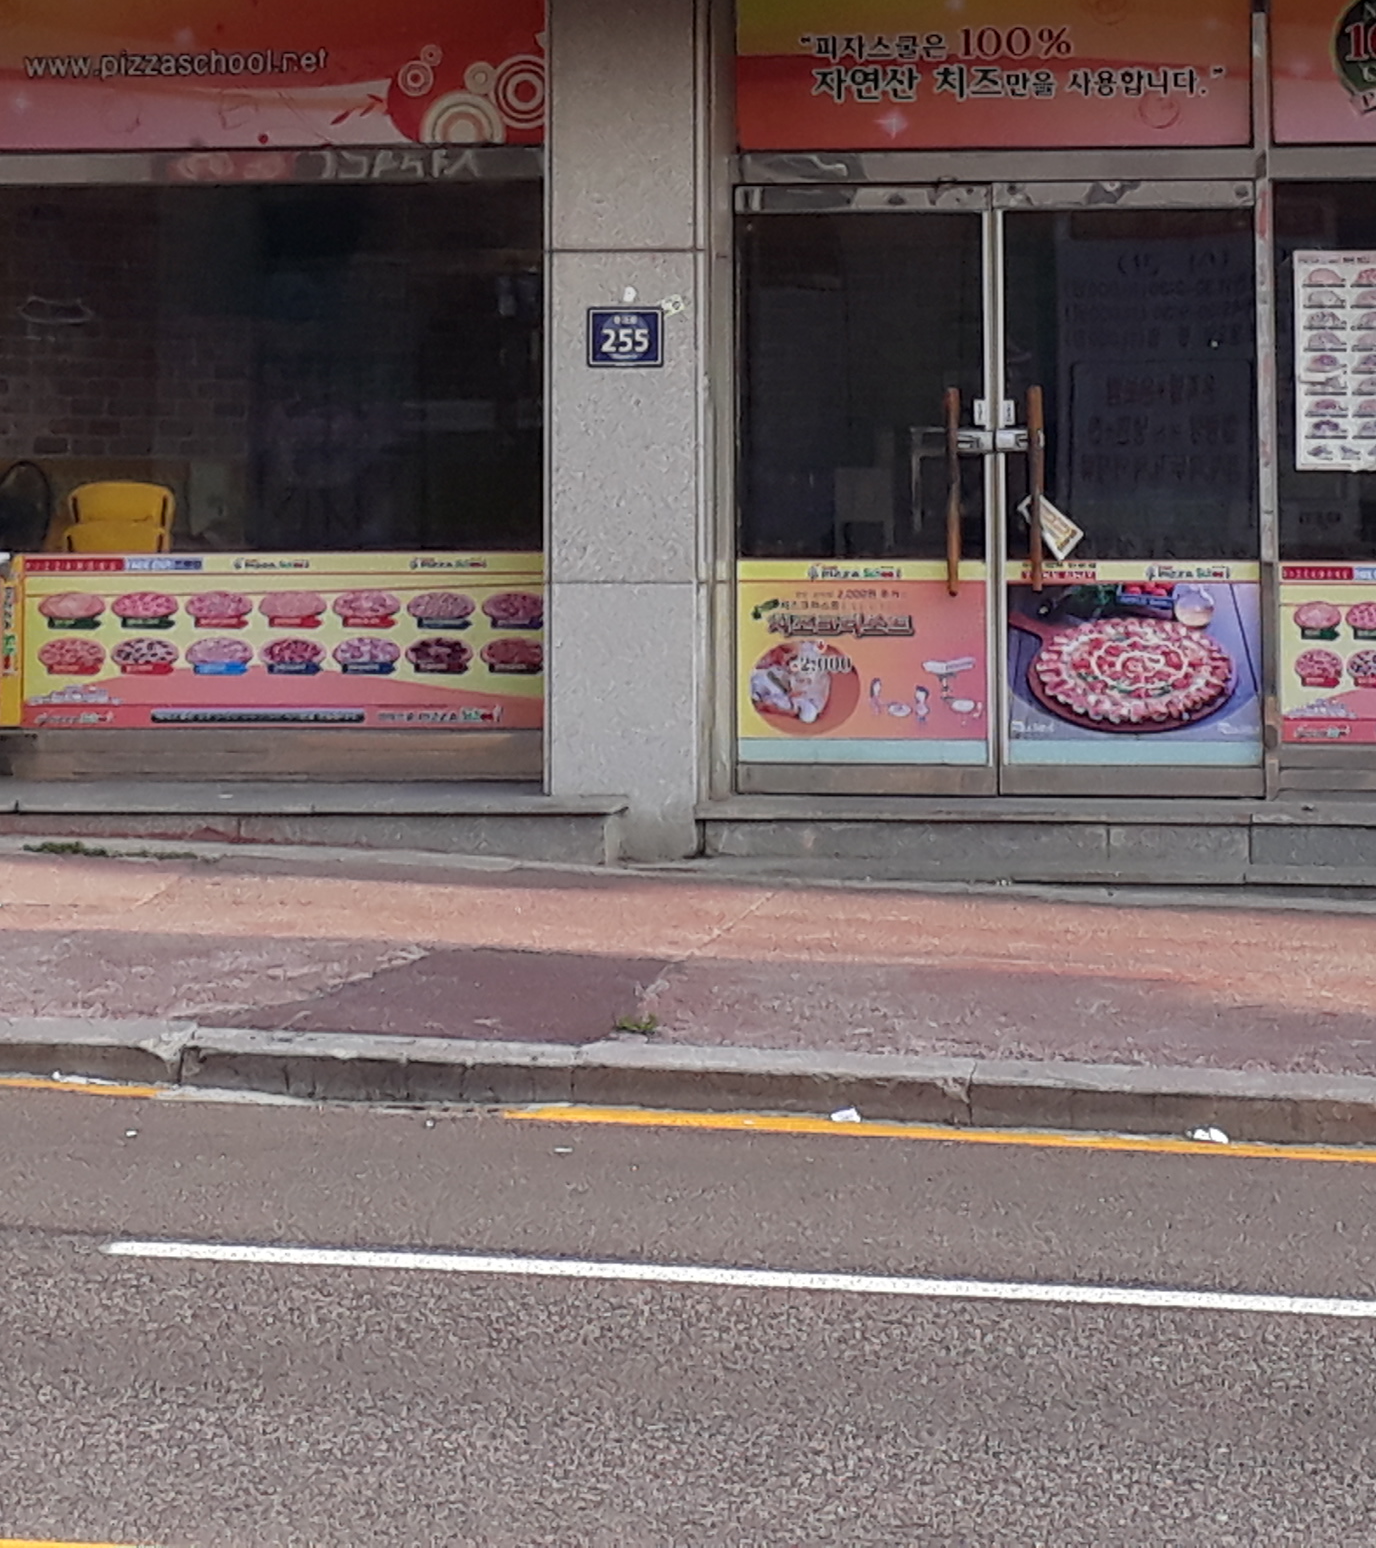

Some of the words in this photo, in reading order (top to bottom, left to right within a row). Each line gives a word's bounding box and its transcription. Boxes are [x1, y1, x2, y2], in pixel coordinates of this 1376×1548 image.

[959, 26, 1073, 59] 100%
[811, 66, 919, 102] 자연산
[935, 66, 1055, 101] 치즈만을
[600, 328, 650, 353] 255
